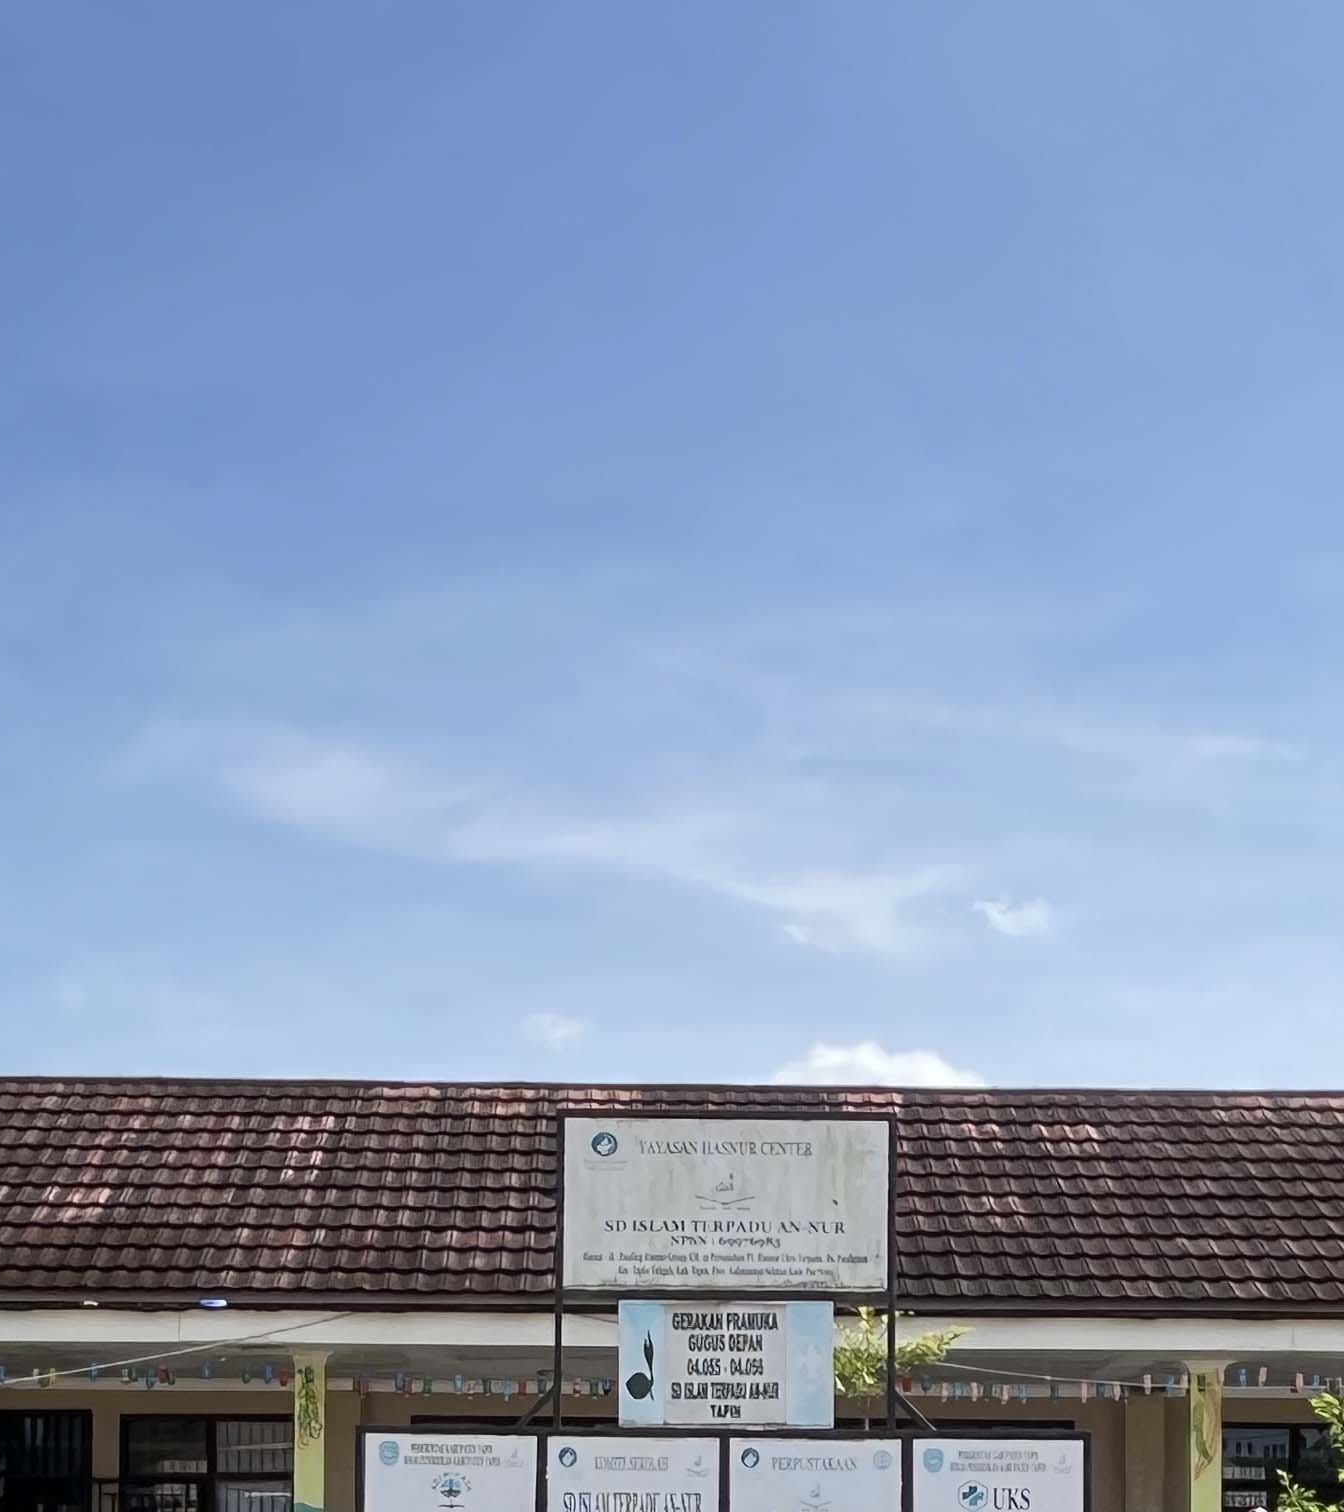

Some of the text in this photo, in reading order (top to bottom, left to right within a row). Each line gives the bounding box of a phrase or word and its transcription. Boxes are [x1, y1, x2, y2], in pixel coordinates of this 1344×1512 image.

[760, 1142, 813, 1157] CENTER
[604, 1219, 627, 1233] SD
[632, 1219, 686, 1233] ISLAM
[672, 1312, 779, 1331] GERAKAN PRAMUKA
[688, 1334, 763, 1352] GUGUS DEPAN
[993, 1487, 1031, 1511] UKS
